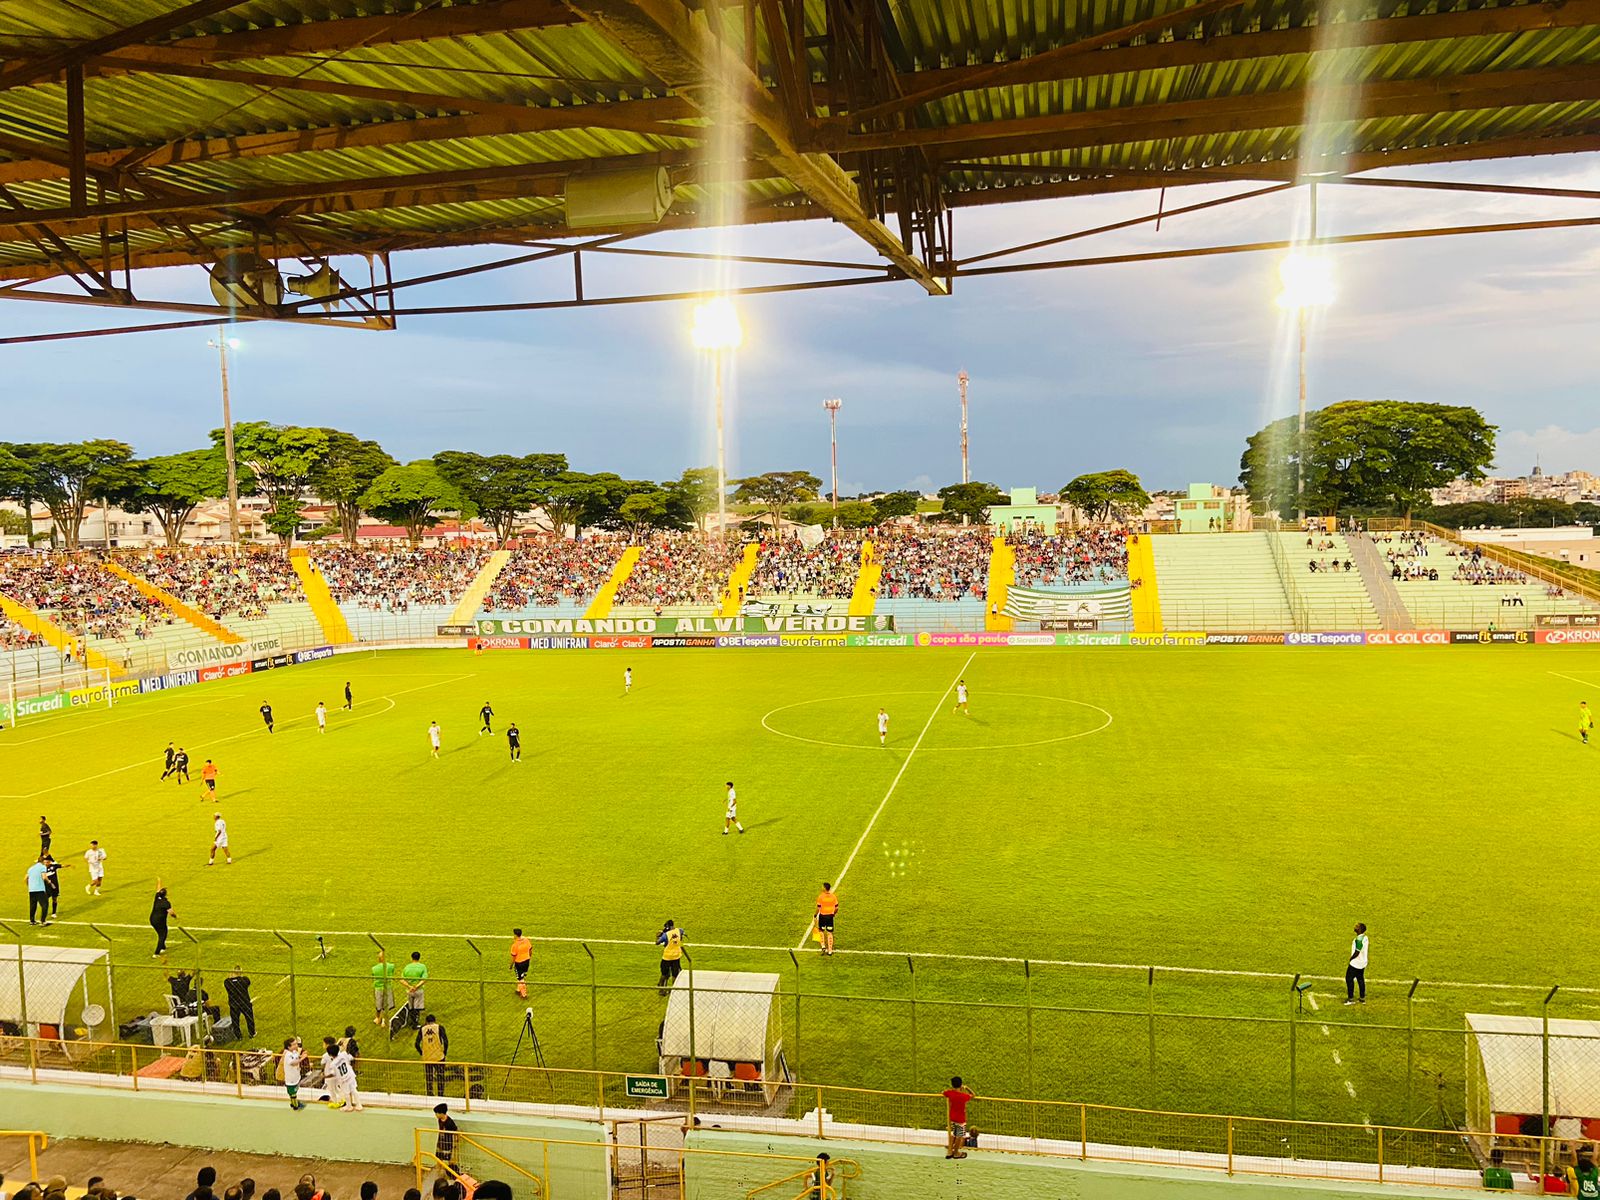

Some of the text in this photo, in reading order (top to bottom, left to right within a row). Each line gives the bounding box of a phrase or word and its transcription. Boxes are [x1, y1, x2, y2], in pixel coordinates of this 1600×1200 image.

[501, 616, 866, 633] COMANDO ALVI VERDE
[866, 635, 907, 646] Sicredi
[932, 633, 1007, 644] copa são paulo
[1077, 634, 1121, 645] Sicredi
[1130, 634, 1205, 645] eurofarma
[1303, 633, 1362, 645] BETesporte
[1368, 632, 1448, 644] GOL GOL GOL
[1567, 630, 1600, 640] KRON
[489, 638, 520, 646] KRONA
[531, 637, 587, 649] MED UNIFRAN
[594, 638, 645, 648] Claro Claro
[728, 637, 778, 648] BETesporte
[781, 636, 846, 647] eurofarma
[177, 643, 243, 665] COMANDO
[251, 638, 281, 653] VERDE
[203, 662, 247, 681] Claro Claro
[141, 670, 198, 693] MED UNIFRAN
[71, 684, 140, 706] eurofarma
[16, 693, 63, 717] Sicredi
[337, 1062, 348, 1076] 10
[631, 1087, 664, 1095] EMERGÊNCIA
